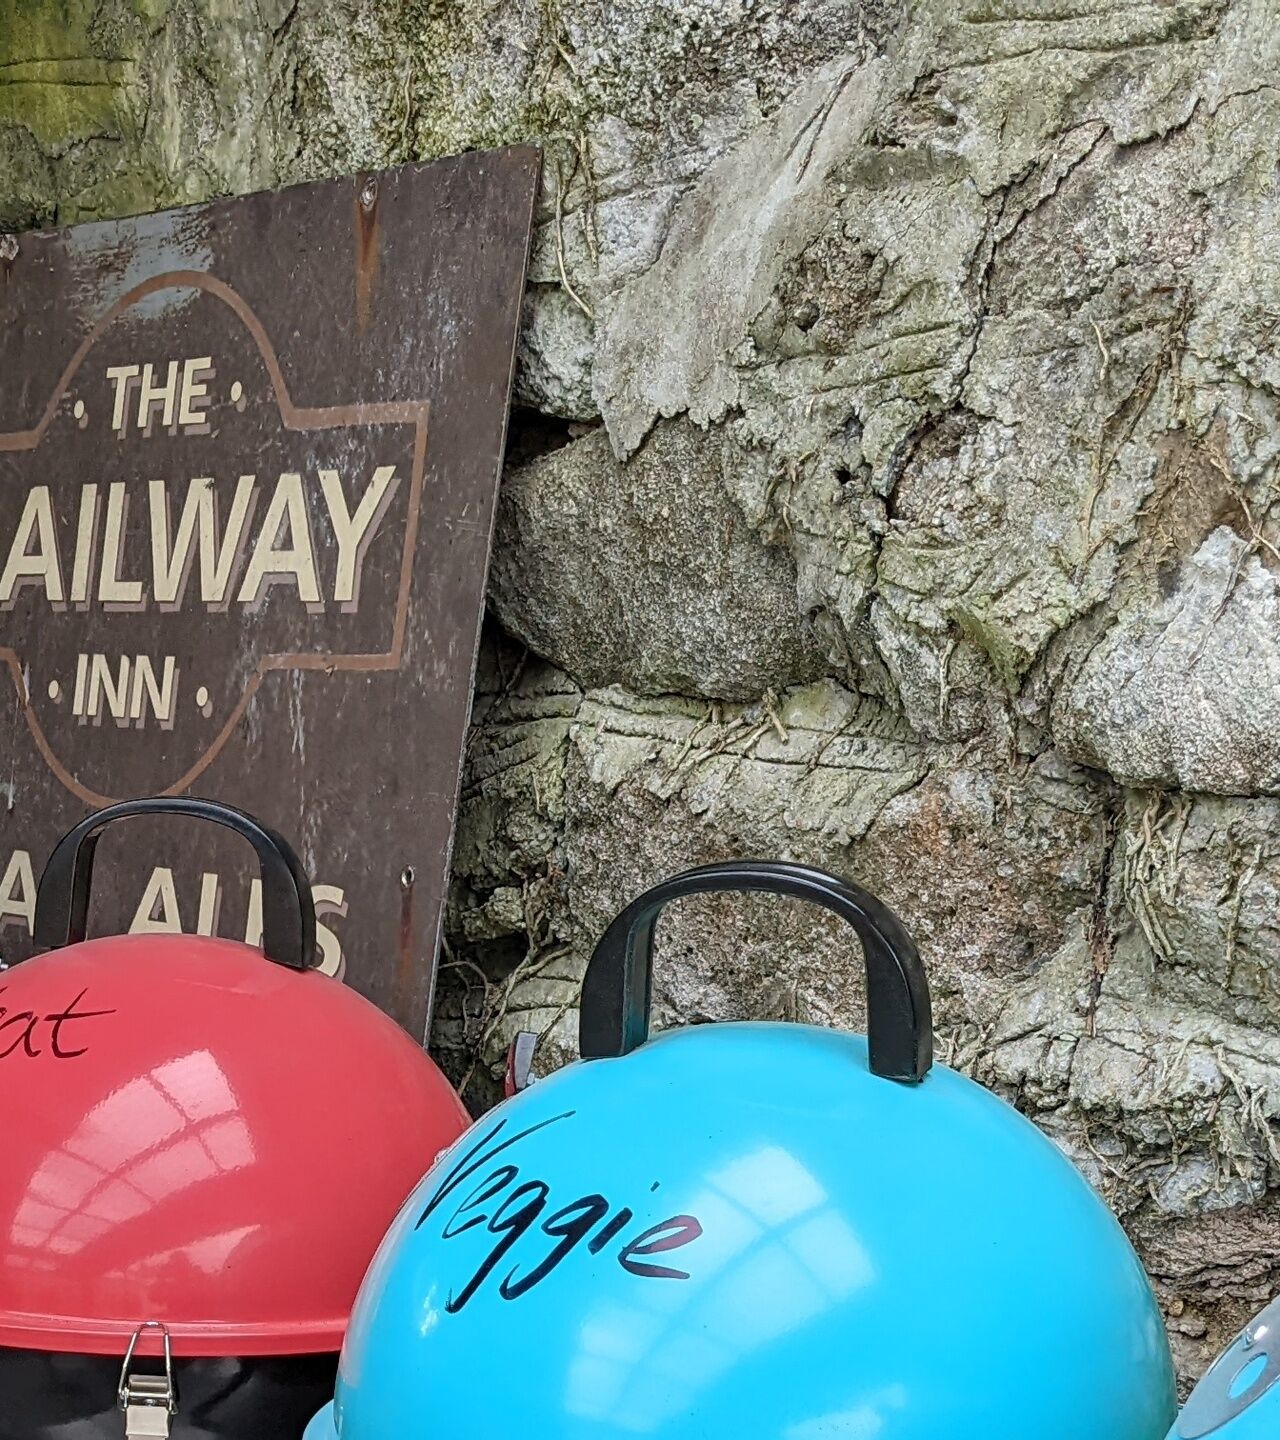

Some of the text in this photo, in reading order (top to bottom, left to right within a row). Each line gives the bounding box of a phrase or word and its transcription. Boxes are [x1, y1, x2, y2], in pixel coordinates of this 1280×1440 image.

[106, 356, 213, 431] THE
[72, 652, 176, 722] INN
[415, 1110, 704, 1313] Veggie
